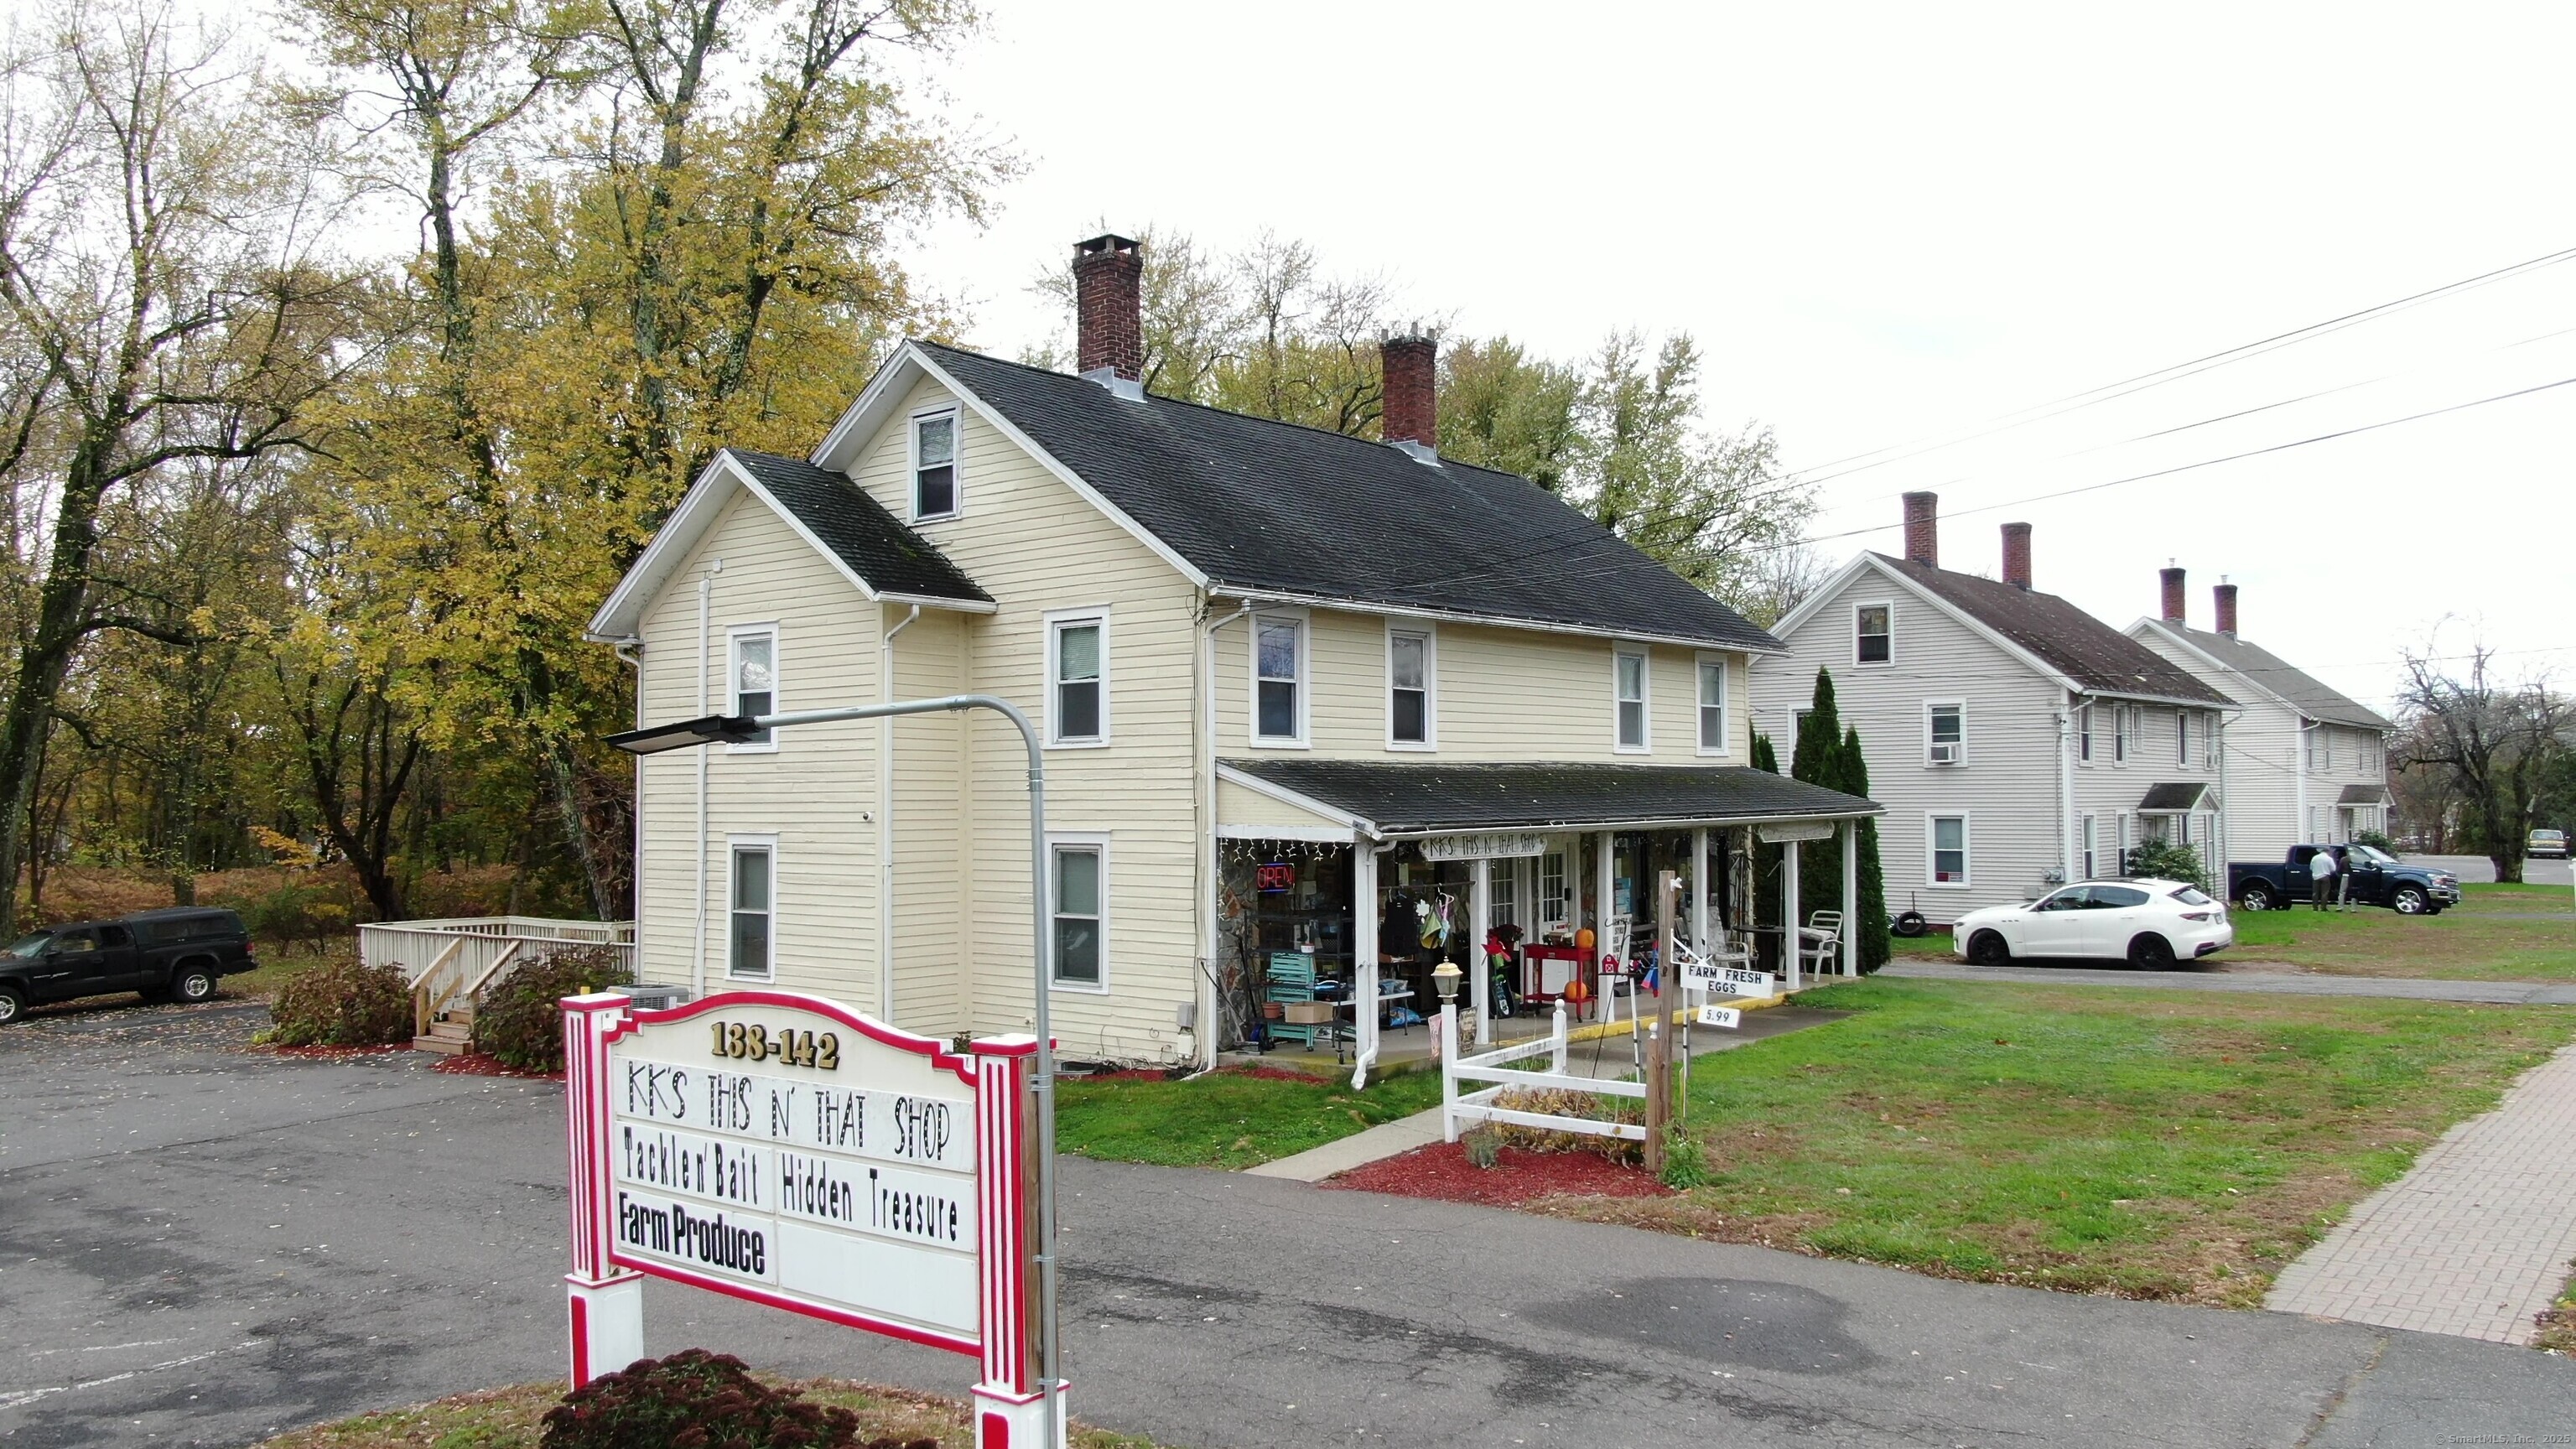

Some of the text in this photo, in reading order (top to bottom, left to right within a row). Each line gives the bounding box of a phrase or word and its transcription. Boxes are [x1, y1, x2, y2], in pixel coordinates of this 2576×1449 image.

[1462, 835, 1478, 855] THIS
[1257, 867, 1292, 888] OPEN
[1689, 965, 1762, 984] FARM FRESH
[1708, 980, 1737, 995] EGGS
[1706, 1010, 1730, 1022] 5.99
[710, 1021, 839, 1071] 138-142
[629, 1061, 688, 1119] KK'S
[708, 1073, 751, 1131] THIS
[815, 1090, 865, 1148] THAT
[894, 1096, 950, 1161] SHOP
[782, 1153, 958, 1242] Hidden Treasure
[619, 1191, 766, 1275] Farm Produce
